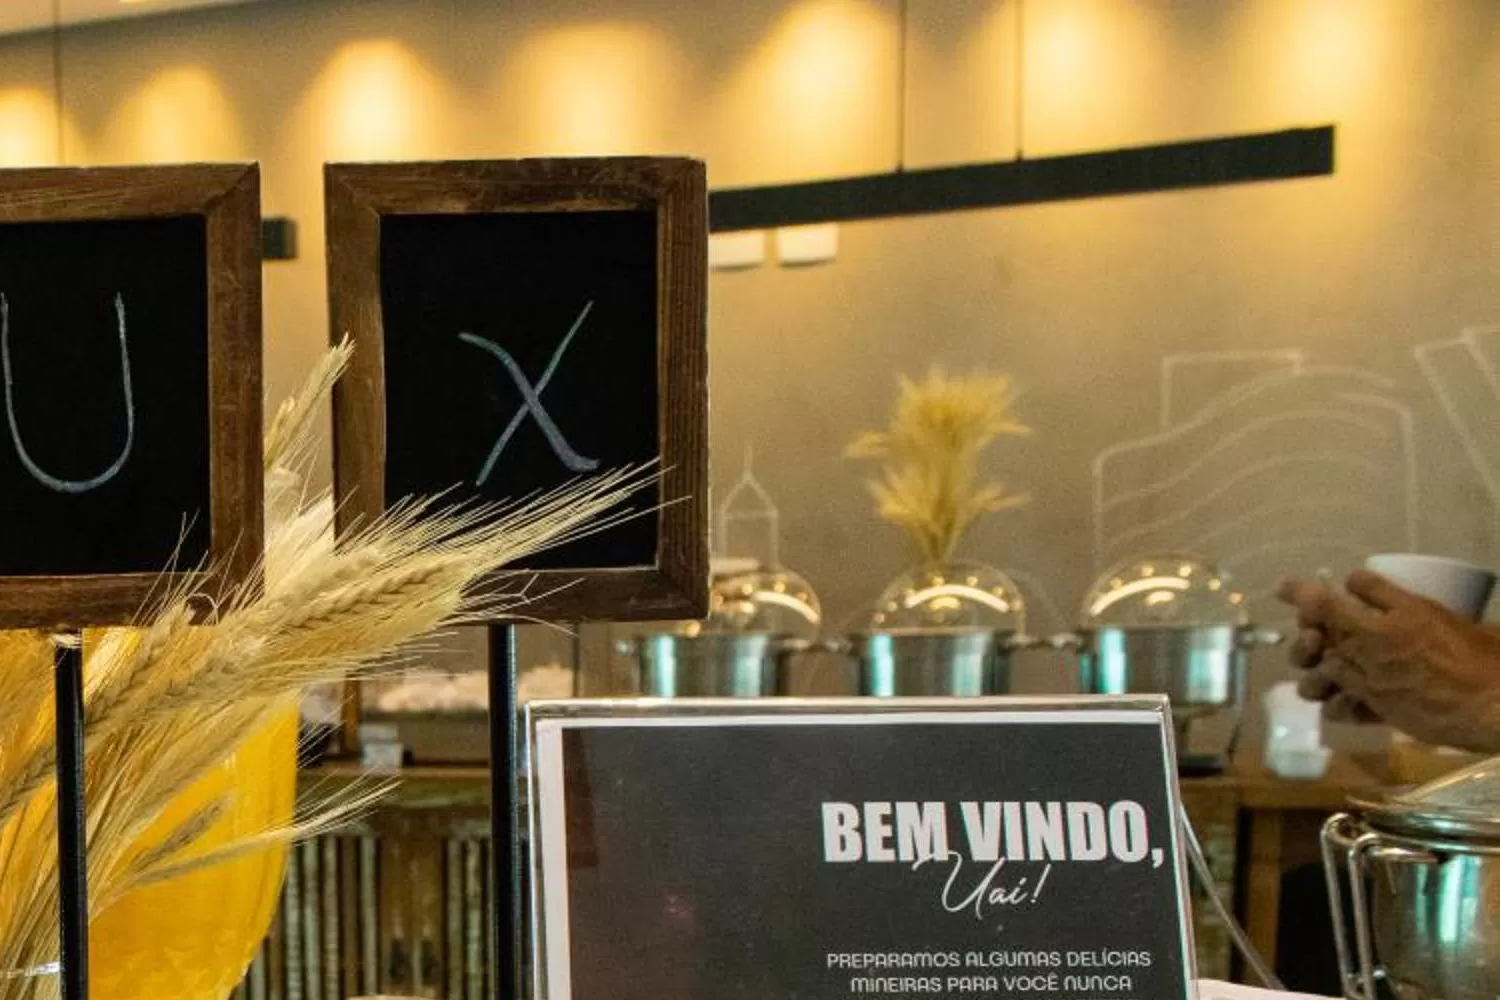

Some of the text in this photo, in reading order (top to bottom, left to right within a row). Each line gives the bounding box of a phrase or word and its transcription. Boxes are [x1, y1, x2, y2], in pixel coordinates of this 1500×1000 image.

[0, 291, 134, 493] U
[457, 300, 600, 487] X
[821, 800, 1164, 868] BEM VINDO,
[911, 850, 1051, 920] Uai!
[827, 947, 1151, 969] PREPARAMOS ALGUMAS DELÍCIAS
[850, 972, 1132, 993] MINEIRAS PARA VOCÊ NUNCA
